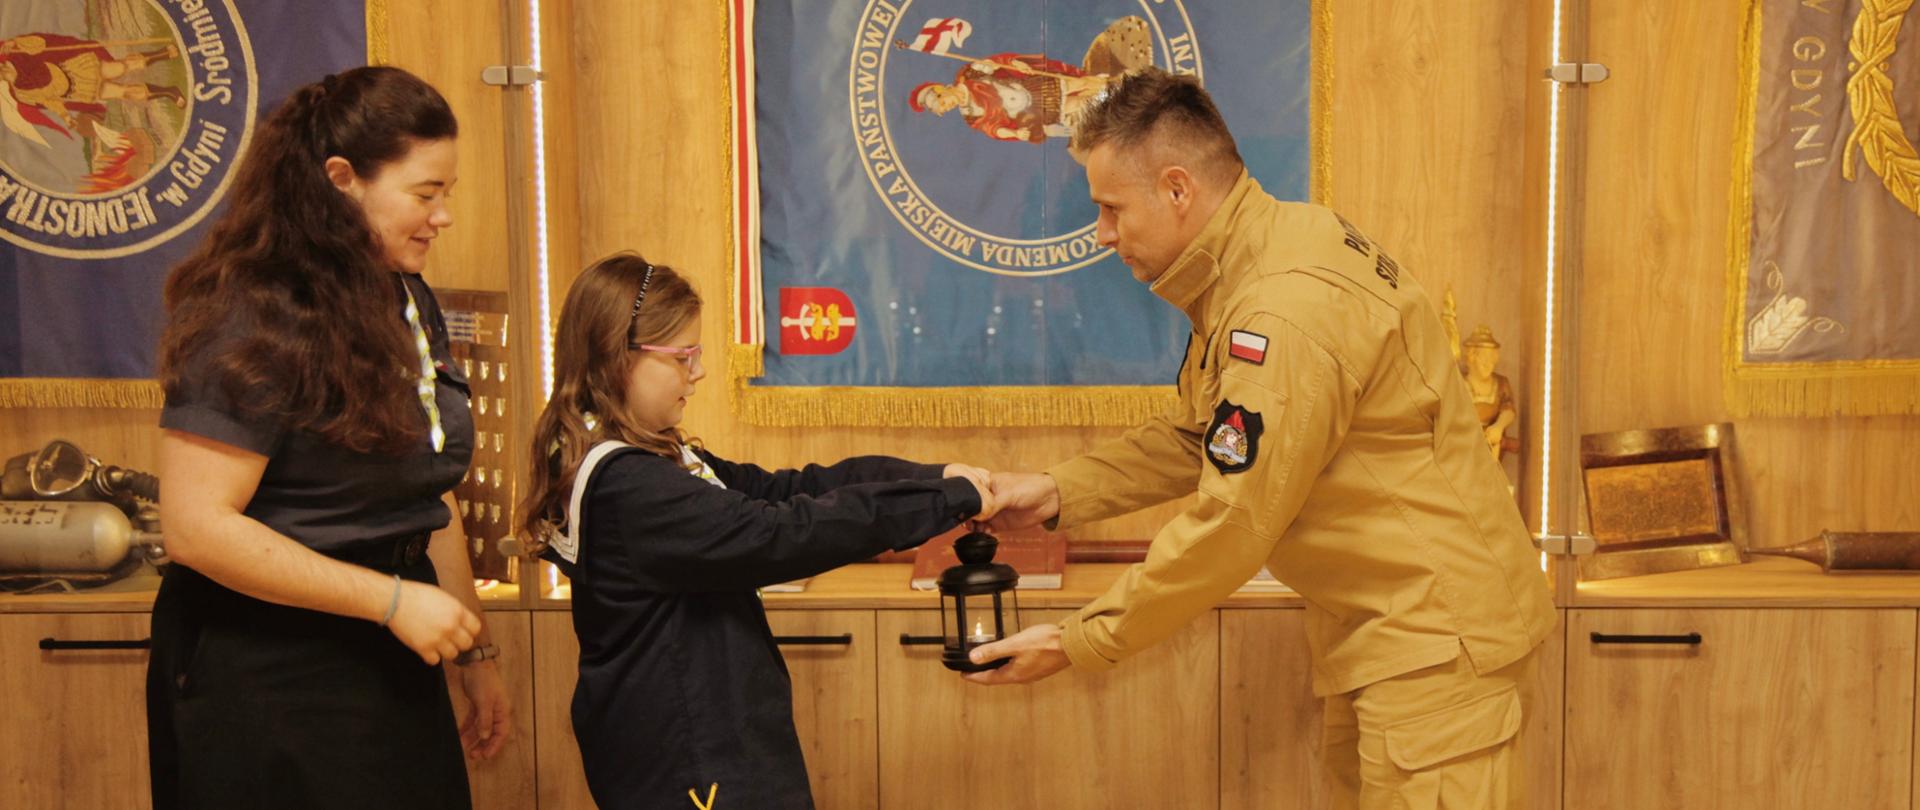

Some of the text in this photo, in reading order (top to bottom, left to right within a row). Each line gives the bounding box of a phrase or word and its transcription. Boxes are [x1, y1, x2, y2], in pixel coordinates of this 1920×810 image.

[170, 118, 227, 189] Gdyni
[857, 0, 1105, 267] KOMENDA MIEJSKA PAŃSTWOWEJ
[1790, 36, 1826, 169] GDYNI
